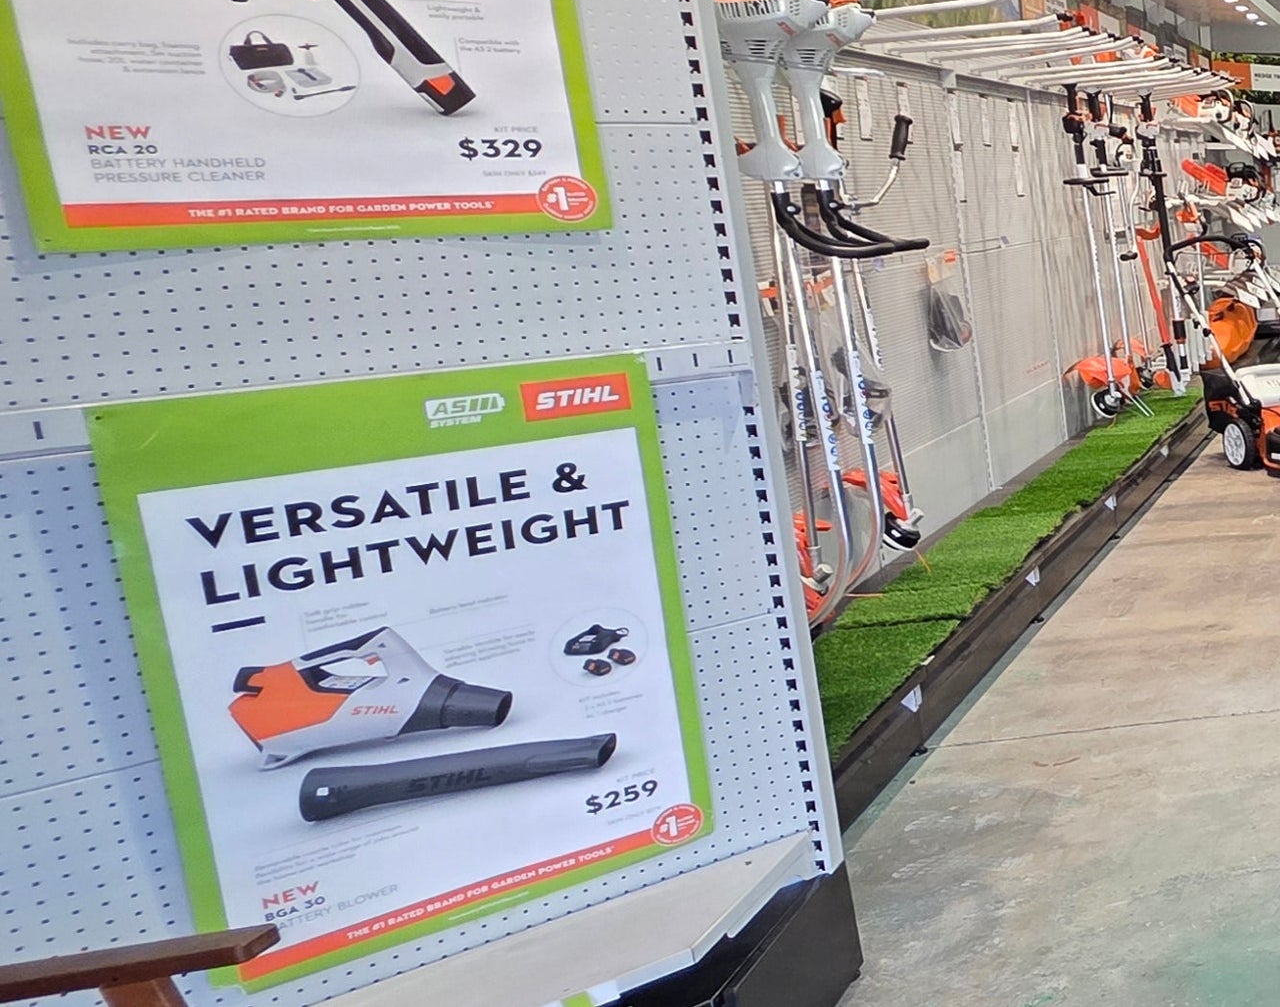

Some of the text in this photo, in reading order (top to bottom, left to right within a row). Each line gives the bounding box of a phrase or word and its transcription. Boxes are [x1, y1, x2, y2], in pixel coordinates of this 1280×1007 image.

[85, 125, 151, 140] NEW
[88, 144, 158, 155] RCA 20
[458, 137, 543, 161] $329
[91, 157, 266, 170] BATTERY HANDHELD
[94, 171, 266, 183] PRESSURE CLEANER
[188, 208, 214, 217] THE
[236, 207, 278, 216] RATED
[281, 205, 324, 215] BRAND
[329, 203, 354, 213] FOR
[357, 202, 407, 212] GARDEN
[409, 201, 452, 211] POWER
[535, 385, 620, 411] STIHL
[429, 414, 483, 429] SYSTEM
[185, 462, 588, 549] VERSATILE &
[200, 500, 630, 606] LIGHTWEIGHT
[351, 705, 399, 716] STIHL
[407, 767, 492, 792] STIHL
[585, 779, 658, 814] $259
[261, 881, 320, 909] NEW
[277, 884, 399, 931] ATTERY BLOWER
[346, 925, 370, 939] THE
[388, 908, 425, 926] RATED
[426, 894, 465, 912] BRAND
[466, 884, 489, 898] FOR
[491, 870, 536, 889] GARDEN
[538, 858, 576, 876] POWER
[264, 896, 326, 922] BGA 30
